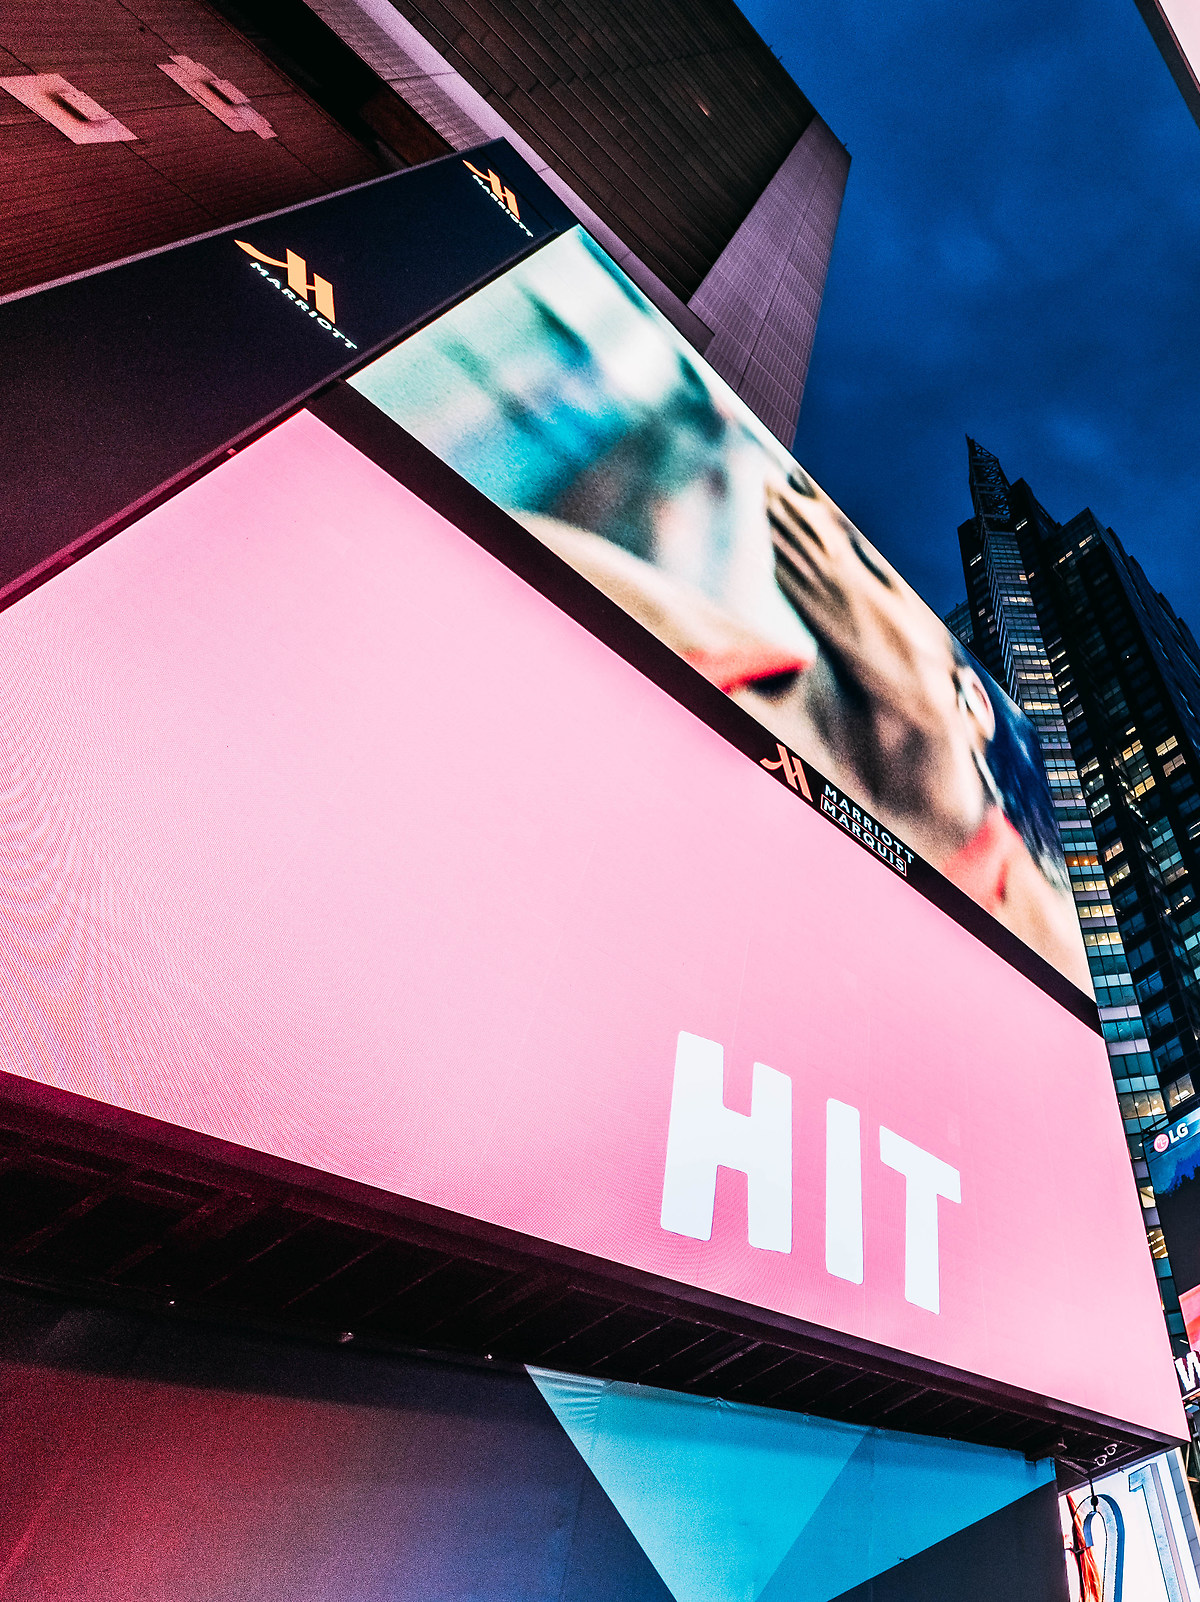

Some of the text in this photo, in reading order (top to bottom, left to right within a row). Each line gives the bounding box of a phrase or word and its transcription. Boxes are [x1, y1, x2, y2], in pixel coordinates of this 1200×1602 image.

[473, 174, 534, 237] MARRIOTT
[250, 261, 358, 350] MARRIOTT
[823, 799, 905, 872] MARQUIS
[824, 784, 915, 864] MARRIOTT
[1168, 1122, 1189, 1144] LG
[660, 1030, 962, 1315] HIT
